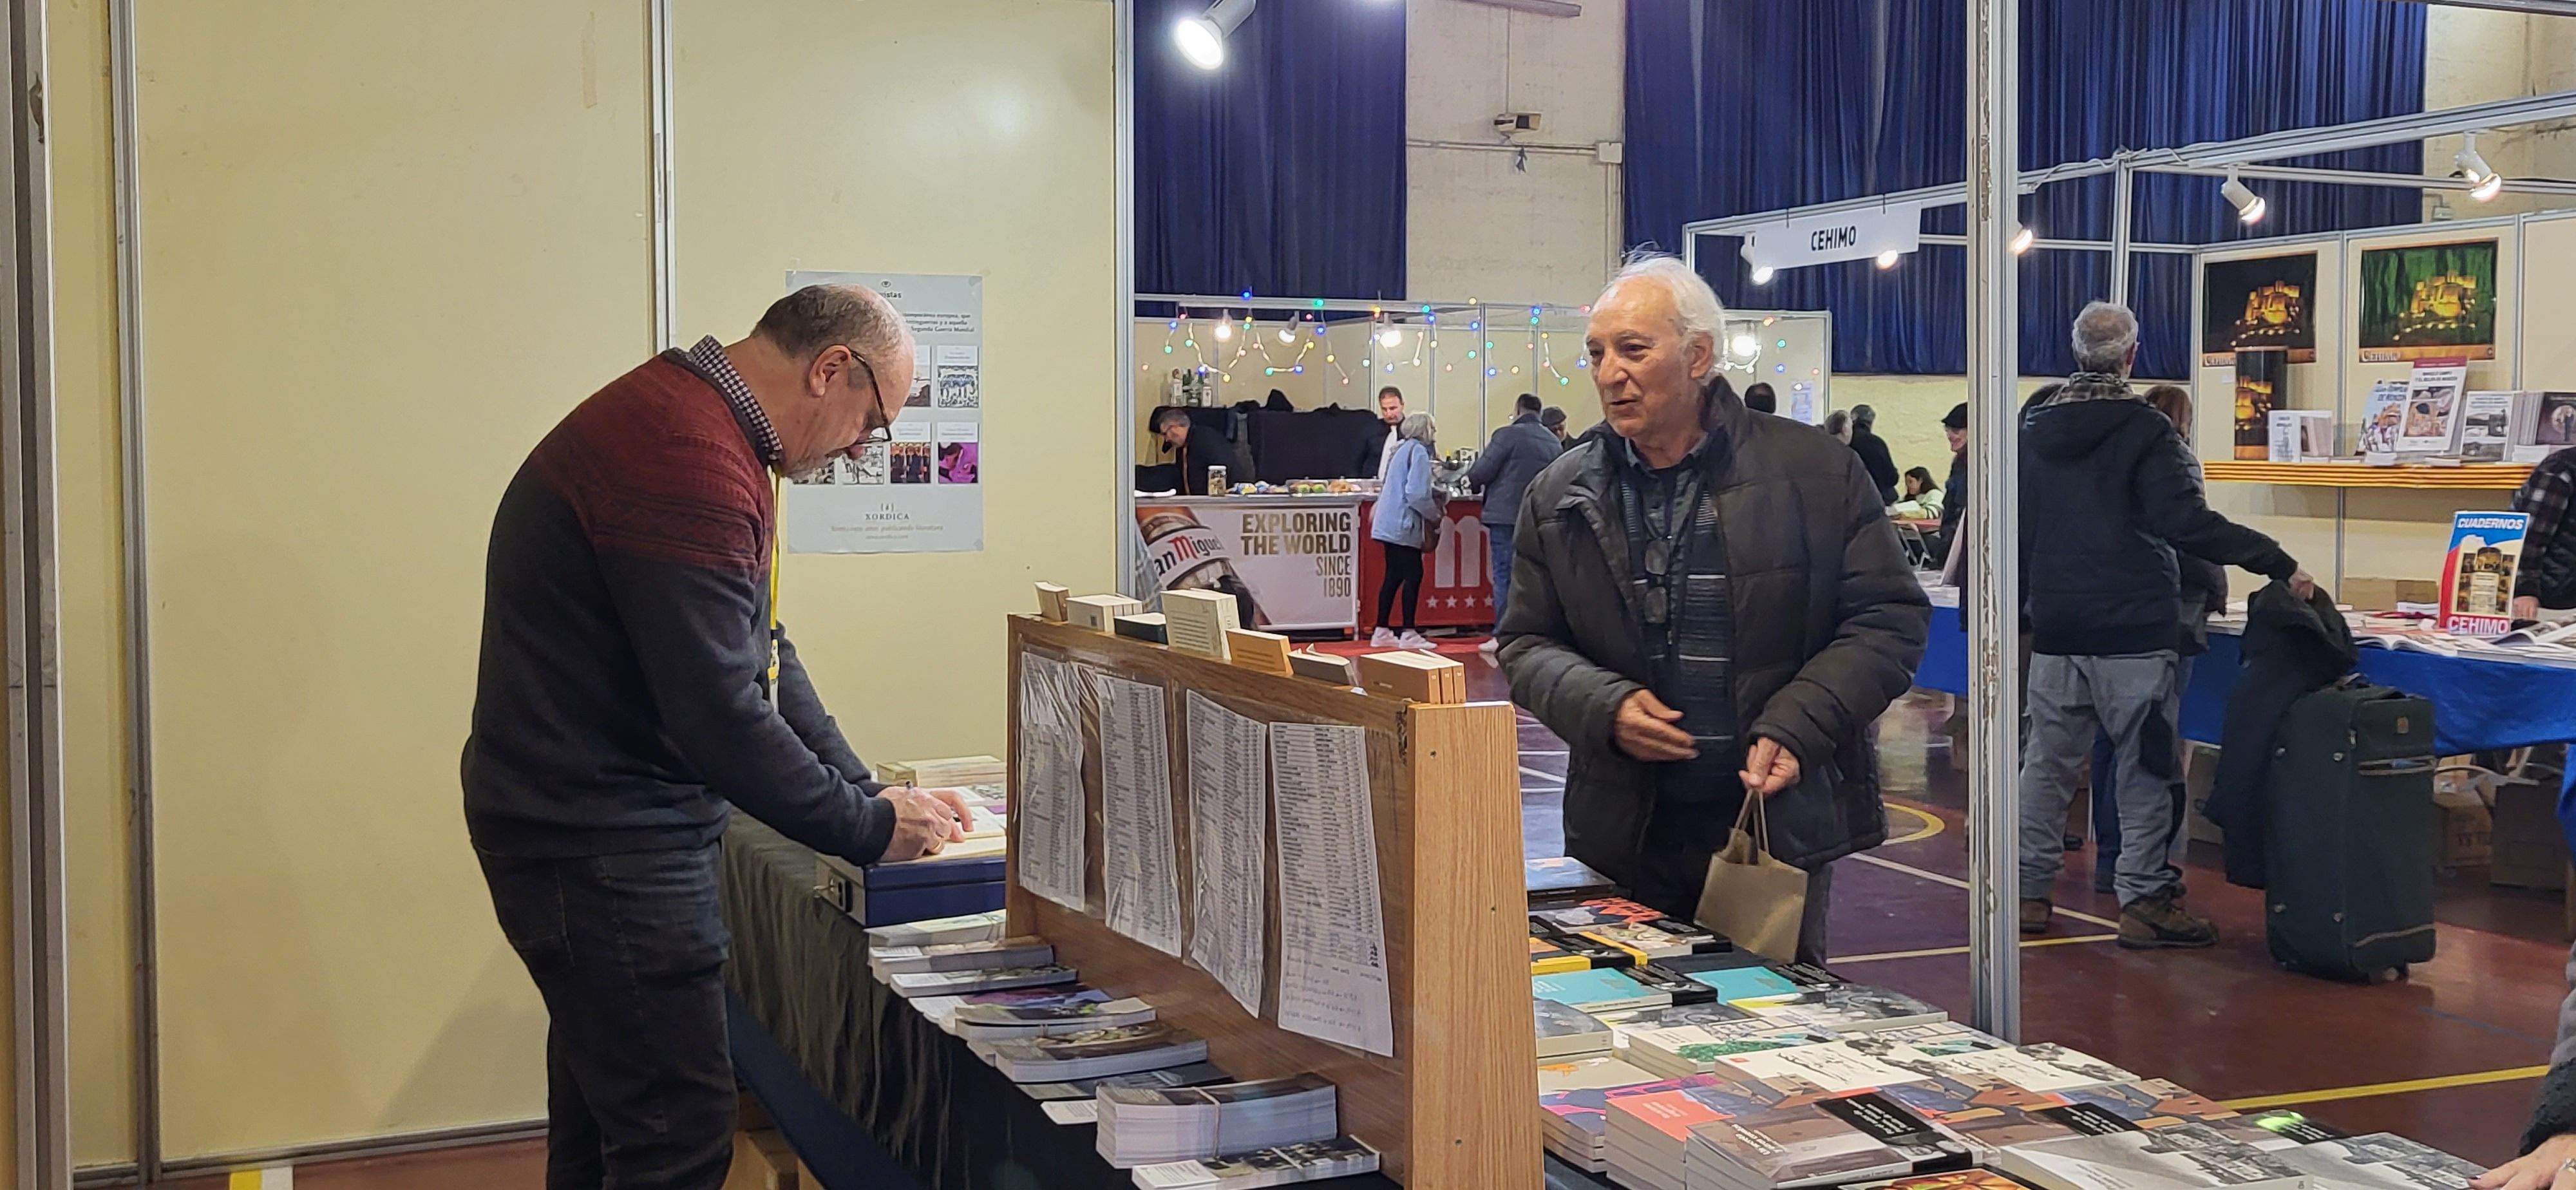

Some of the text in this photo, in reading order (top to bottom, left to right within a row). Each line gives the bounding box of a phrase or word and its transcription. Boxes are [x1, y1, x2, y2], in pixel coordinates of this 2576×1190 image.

[1811, 225, 1856, 251] CEHIMO
[1242, 512, 1351, 533] EXPLORING
[2458, 518, 2524, 529] CUADERNOS
[1241, 534, 1351, 555] THE WORLD
[1316, 556, 1351, 576] SINCE
[1323, 577, 1351, 598] 1890
[2448, 616, 2510, 635] CEHIMO
